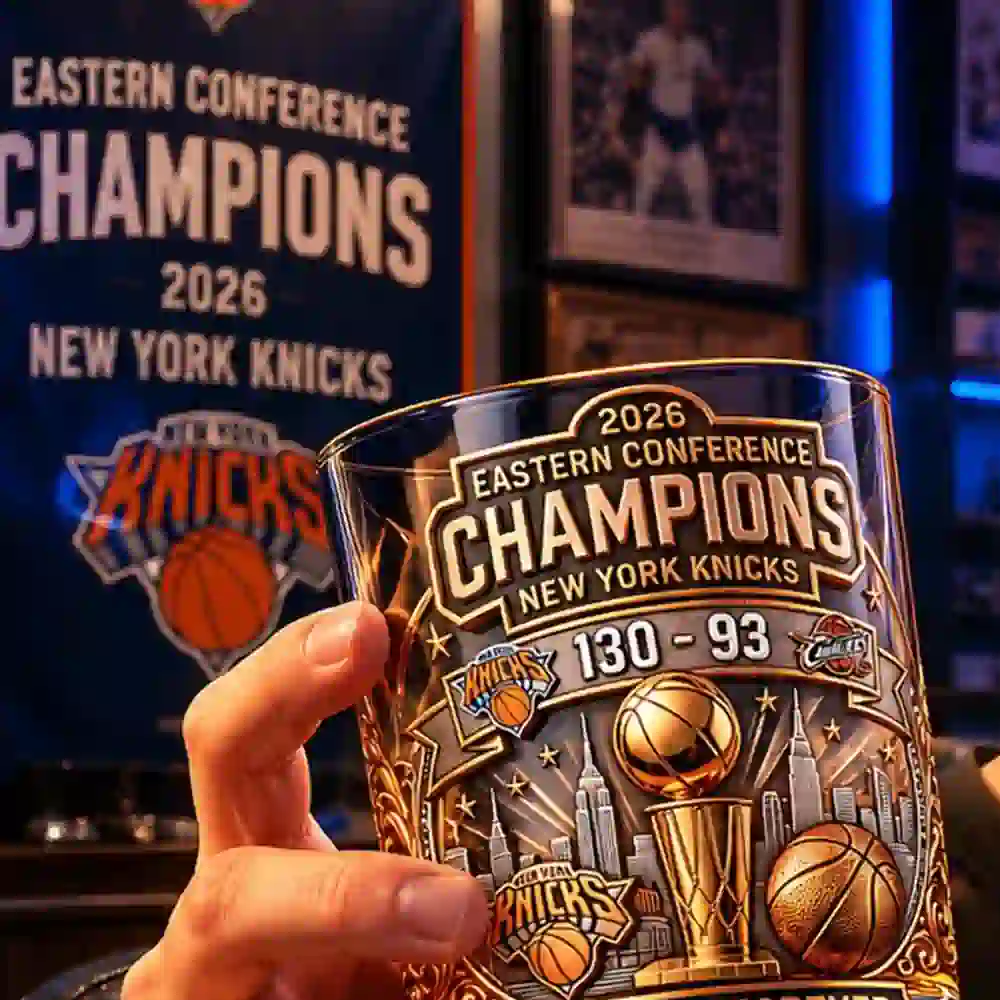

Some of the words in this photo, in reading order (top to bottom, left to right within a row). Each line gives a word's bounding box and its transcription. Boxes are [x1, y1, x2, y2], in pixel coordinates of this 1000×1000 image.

[12, 56, 175, 110] EASTERN
[185, 65, 411, 153] CONFERENCE
[0, 129, 432, 289] CHAMPIONS
[160, 261, 267, 318] 2026
[28, 323, 118, 379] NEW
[131, 327, 236, 387] YORK
[250, 338, 393, 404] KNICKS
[599, 402, 686, 436] 2026
[471, 444, 612, 498] EASTERN
[621, 435, 811, 469] CONFERENCE
[442, 471, 852, 600] CHAMPIONS
[517, 566, 586, 615] NEW
[596, 556, 681, 592] YORK
[690, 554, 799, 585] KNICKS
[573, 618, 662, 681] 130
[707, 612, 771, 662] 93
